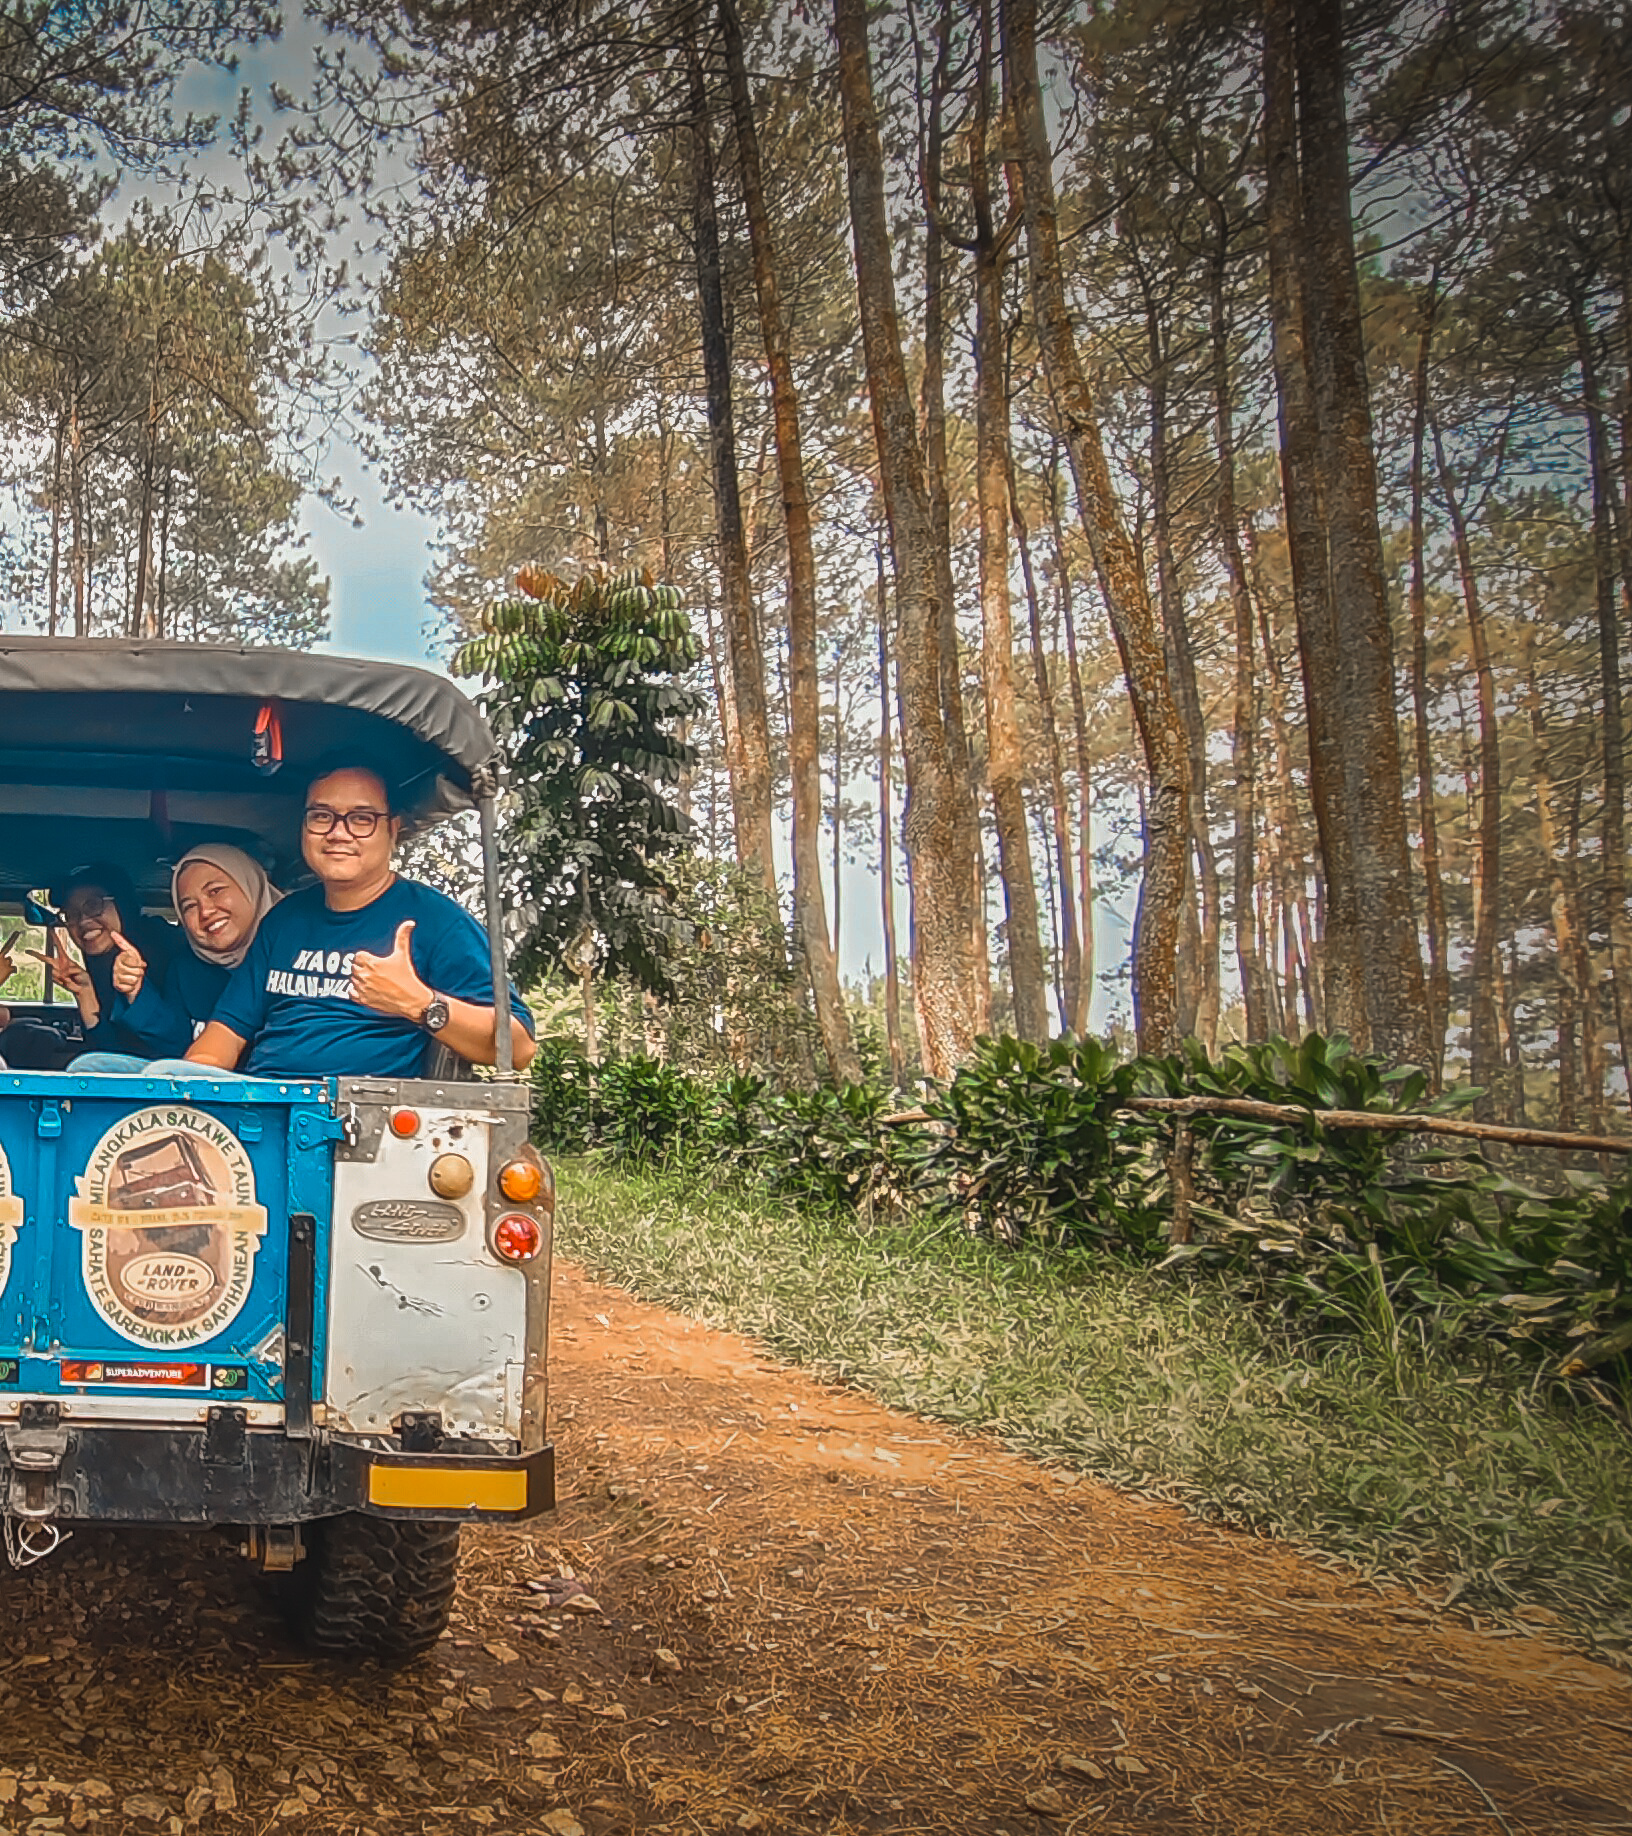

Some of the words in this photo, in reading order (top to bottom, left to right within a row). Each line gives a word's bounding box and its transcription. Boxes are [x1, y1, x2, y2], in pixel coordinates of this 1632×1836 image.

[292, 949, 355, 975] KAOS
[90, 1113, 162, 1205] MILANGKALA
[166, 1111, 236, 1156] SALAWE
[230, 1156, 251, 1206] TAUN
[89, 1227, 110, 1304] SAHATE
[103, 1300, 200, 1344] SARENGKAK
[202, 1231, 249, 1332] SAPIHANEAN
